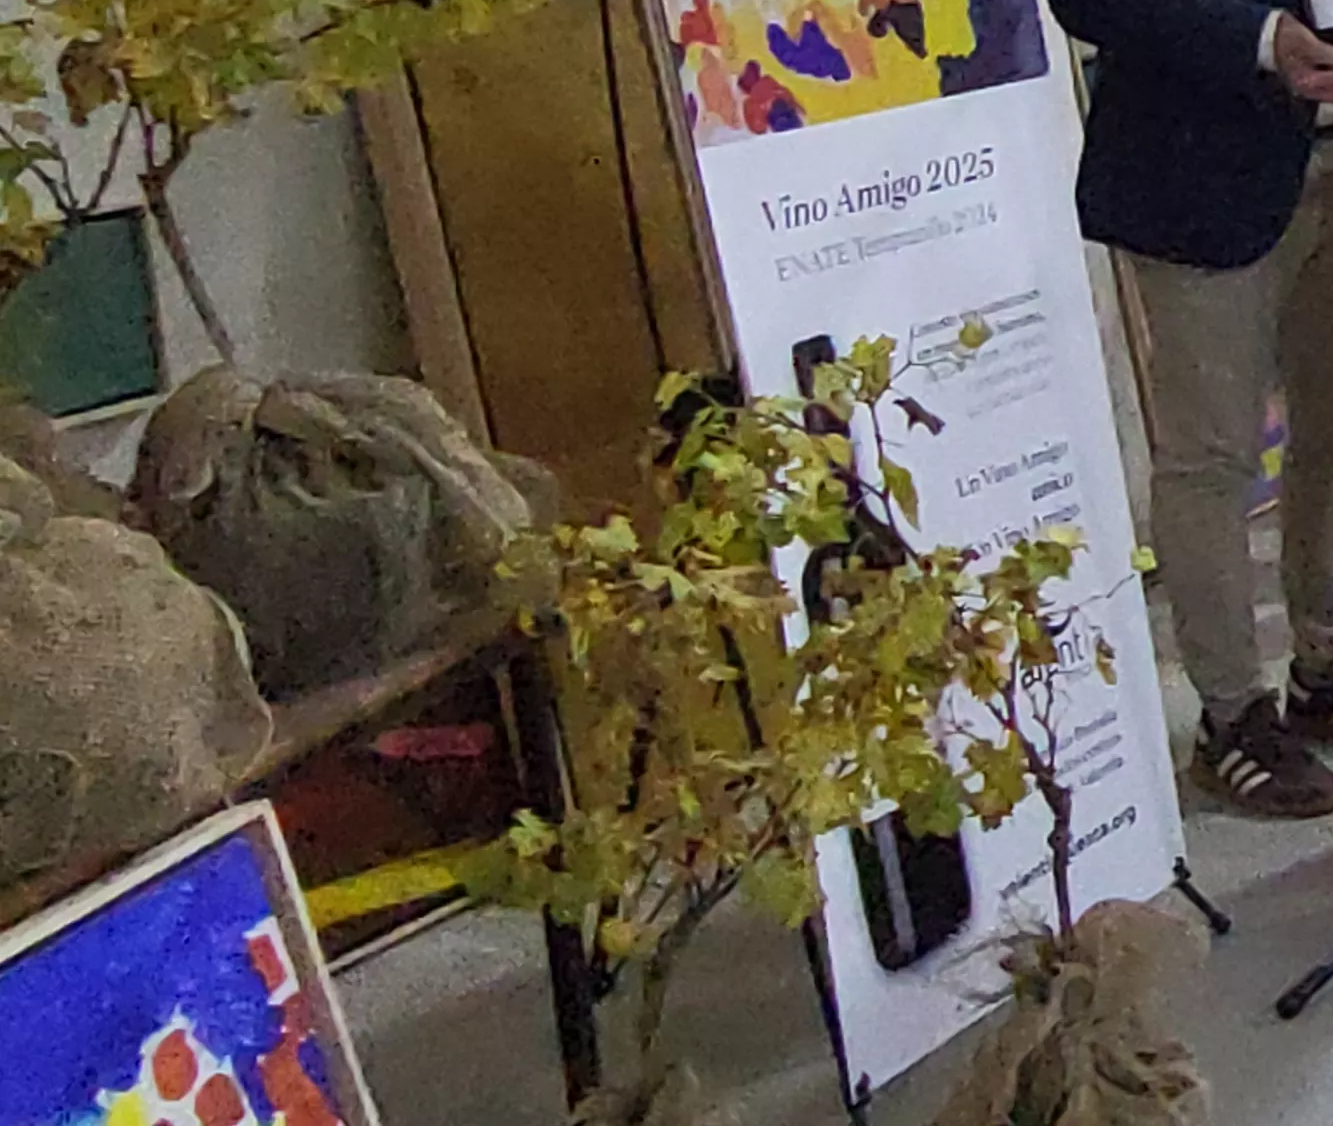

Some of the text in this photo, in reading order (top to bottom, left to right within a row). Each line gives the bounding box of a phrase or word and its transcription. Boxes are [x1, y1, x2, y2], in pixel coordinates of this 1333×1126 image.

[761, 147, 995, 232] Vino Amigo 2025
